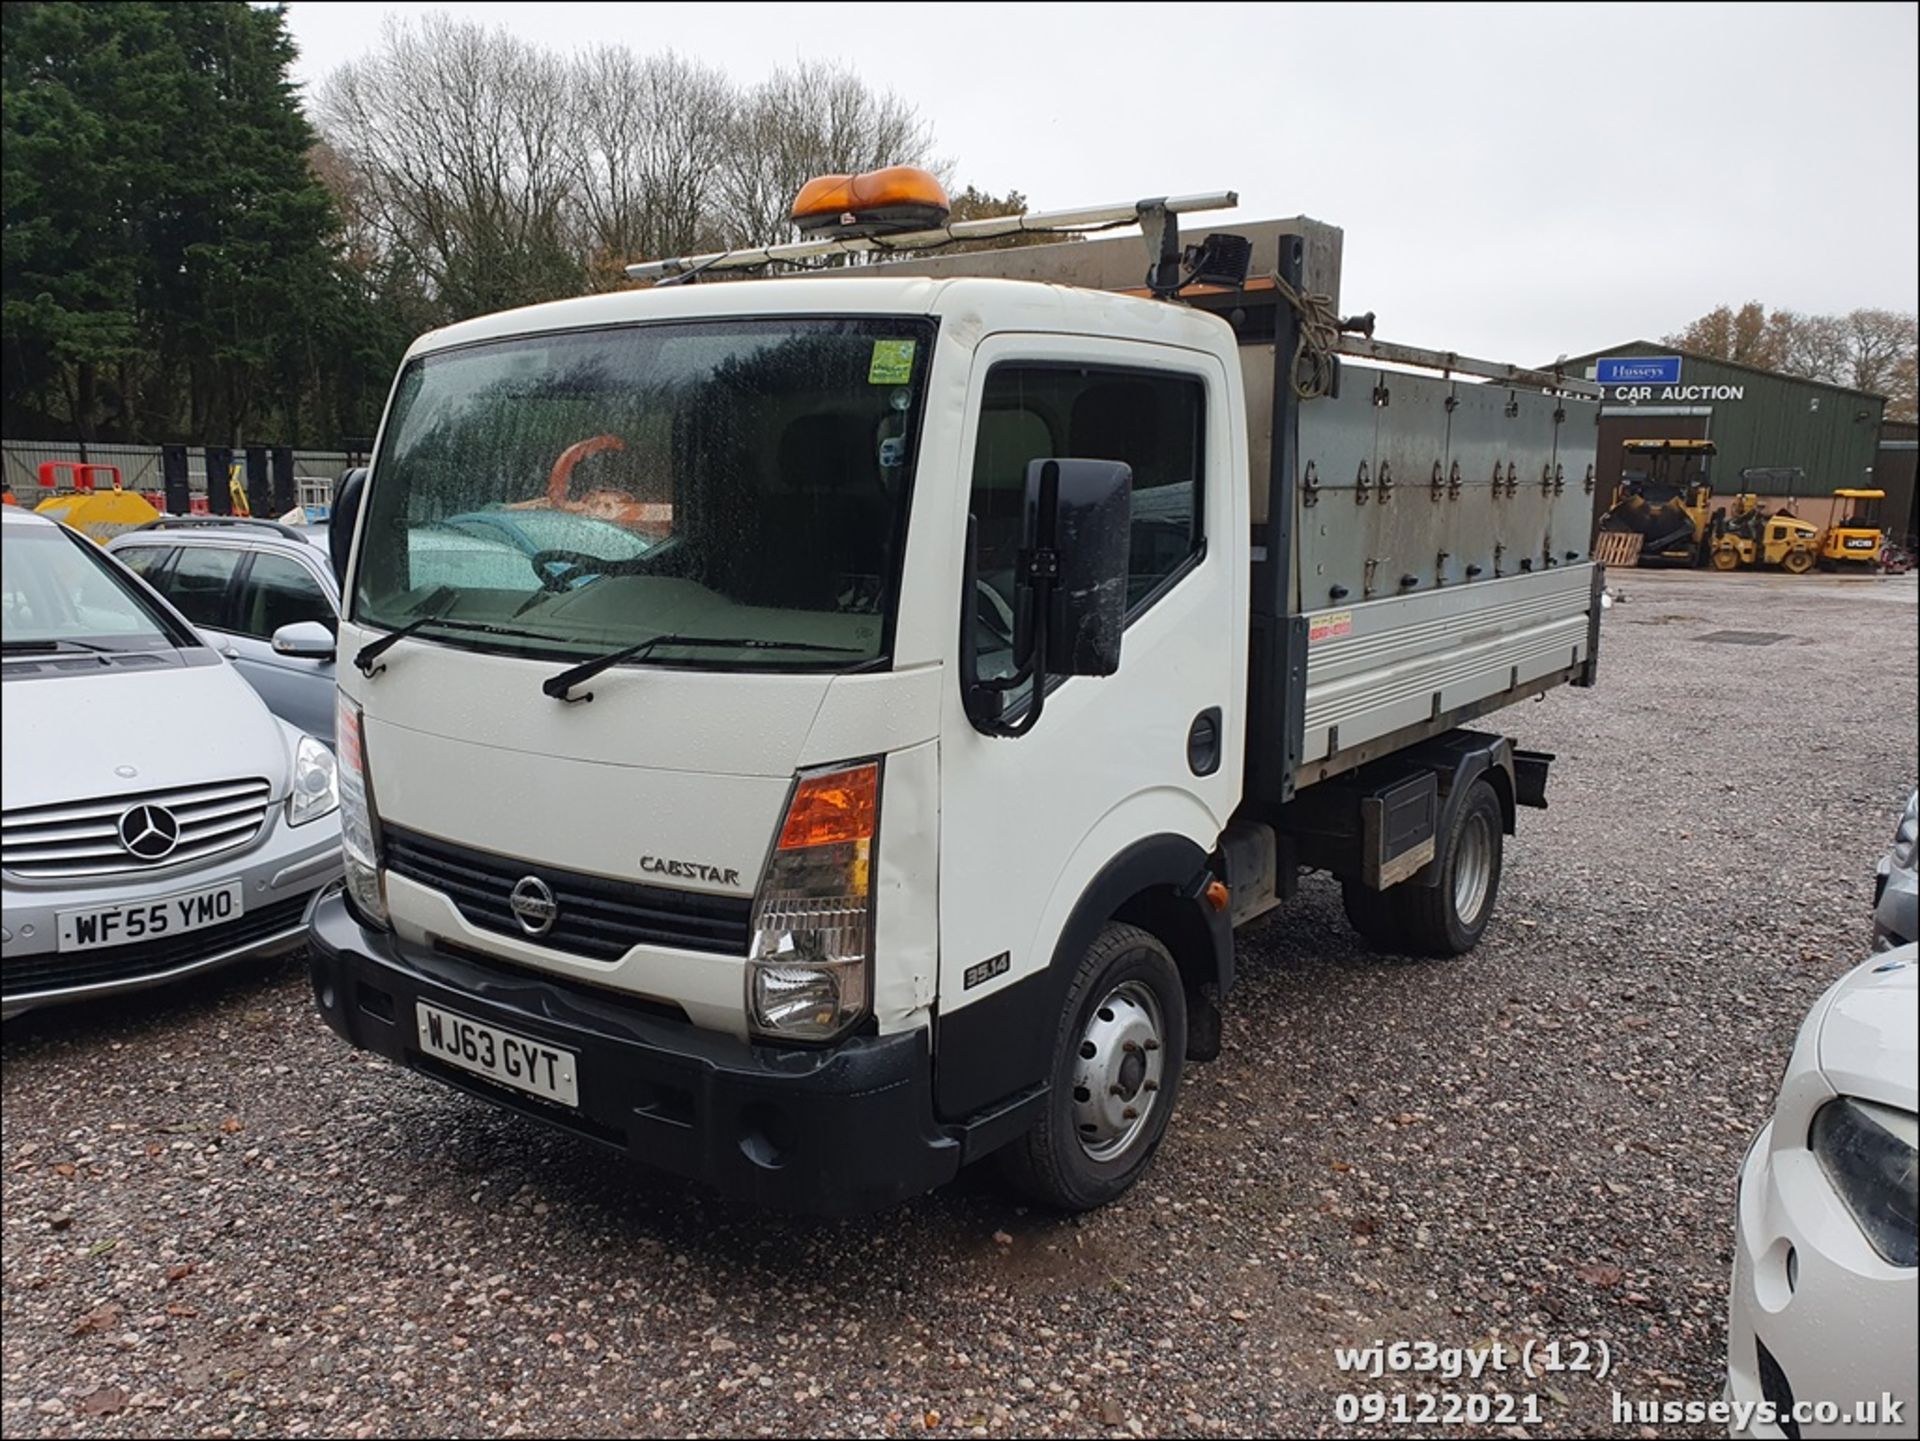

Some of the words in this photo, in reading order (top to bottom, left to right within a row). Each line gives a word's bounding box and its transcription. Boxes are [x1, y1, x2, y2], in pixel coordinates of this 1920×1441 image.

[1612, 365, 1664, 378] Husseys
[1615, 386, 1651, 400] CAR
[1661, 386, 1744, 400] AUCTION
[640, 856, 740, 886] CABSTAR
[76, 904, 168, 944] WF55
[178, 890, 231, 927] YMO
[967, 954, 1008, 987] 35.14
[427, 1011, 496, 1068] WJ63
[503, 1038, 559, 1090] GYT
